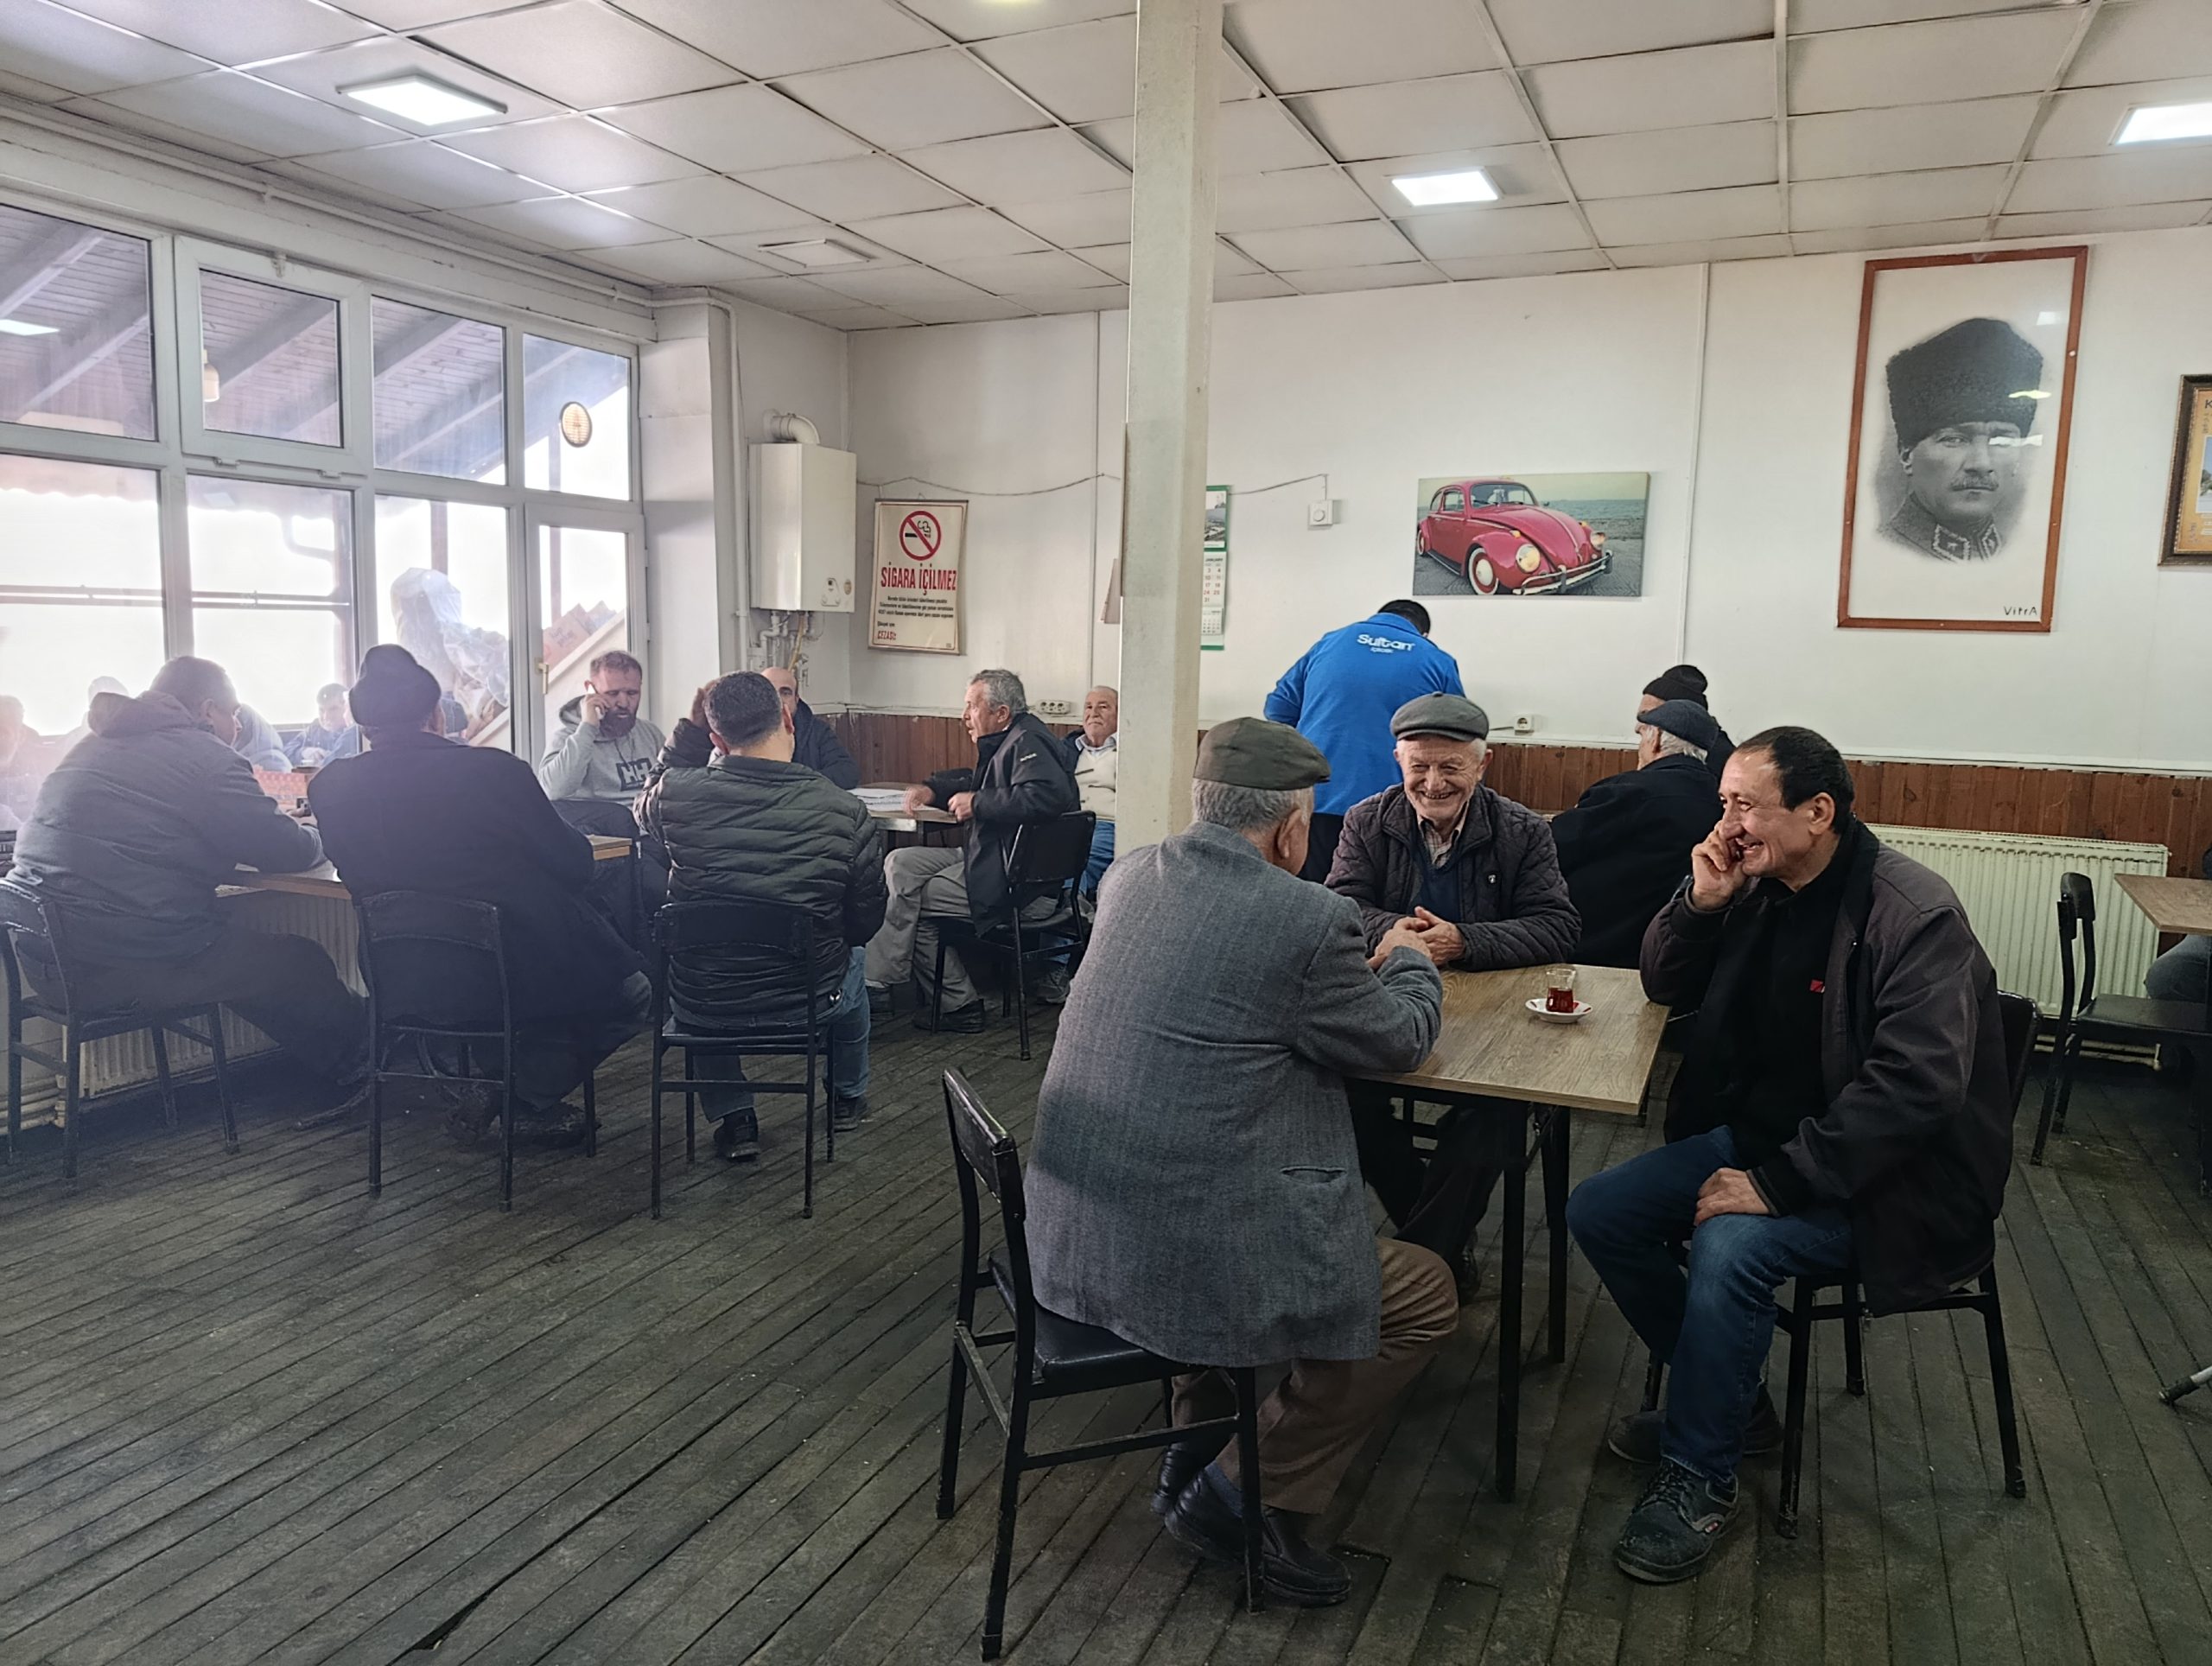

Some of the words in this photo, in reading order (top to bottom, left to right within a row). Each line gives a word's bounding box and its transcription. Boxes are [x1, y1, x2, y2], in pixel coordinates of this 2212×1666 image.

[880, 562, 916, 588] SİGARA
[918, 563, 957, 595] İÇİLMEZ
[1357, 633, 1414, 652] Sultan
